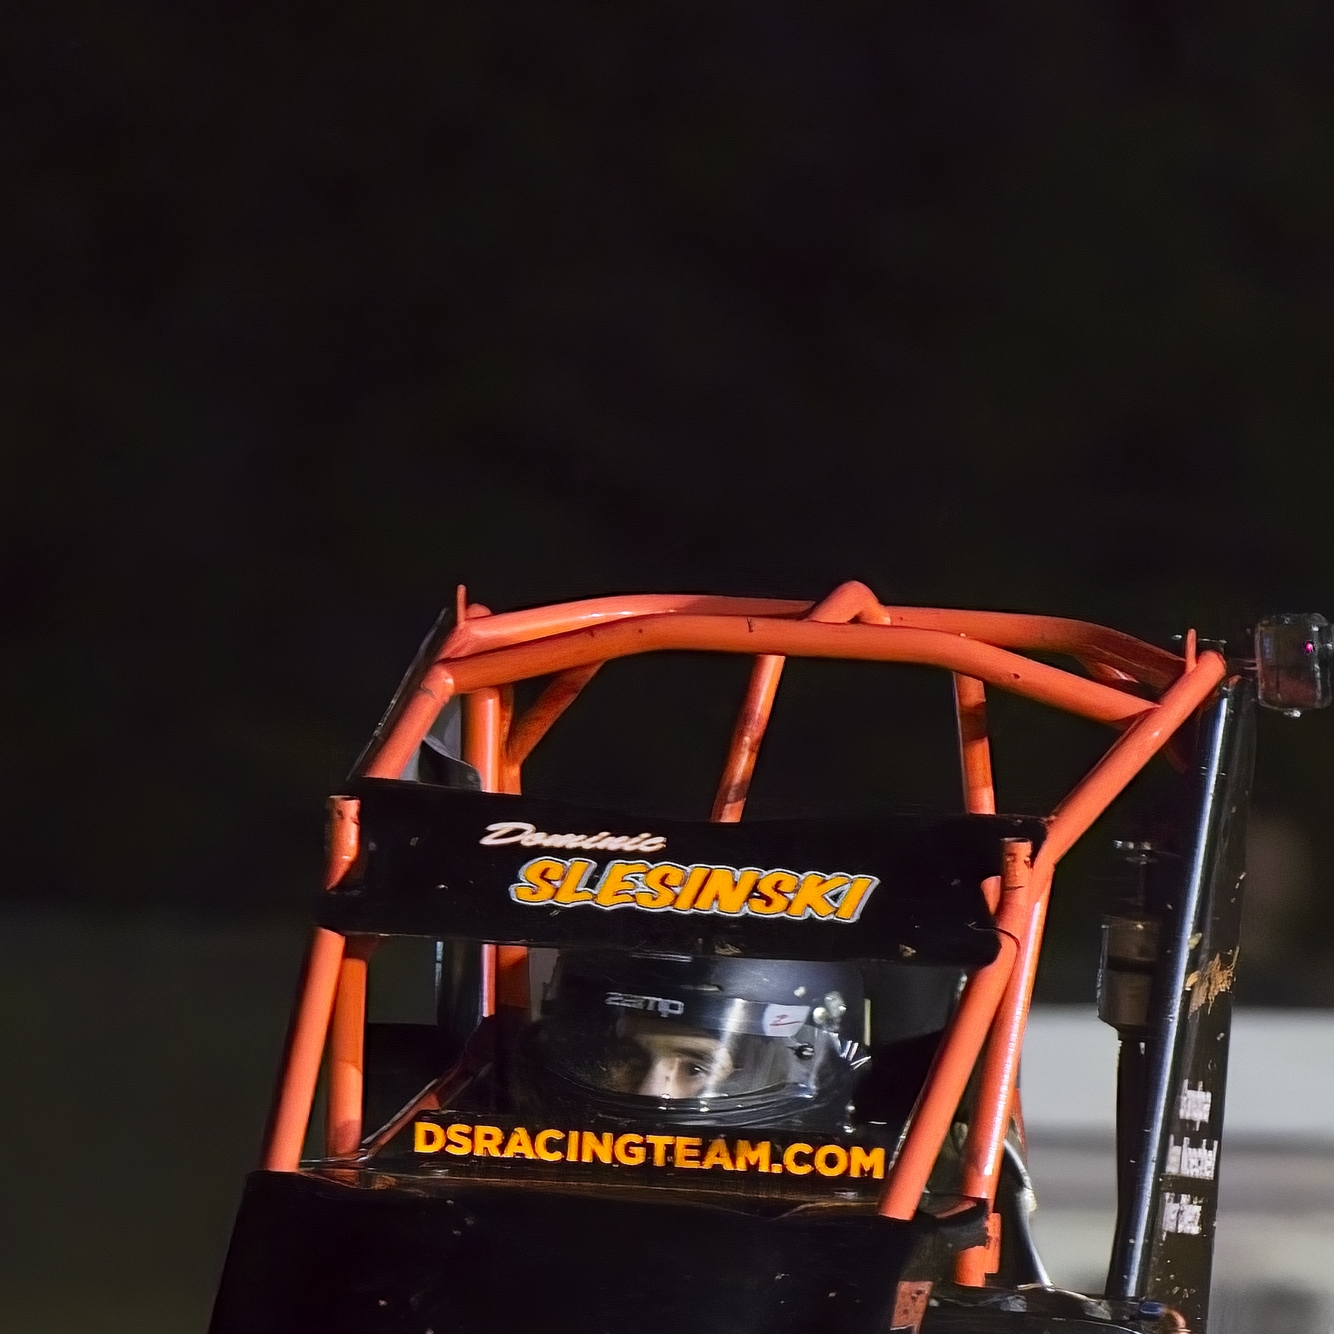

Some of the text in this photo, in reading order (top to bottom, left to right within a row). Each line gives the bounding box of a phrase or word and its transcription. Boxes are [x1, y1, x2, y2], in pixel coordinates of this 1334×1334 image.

[479, 821, 667, 852] Dominic
[511, 857, 880, 923] SLESINSKI
[413, 1120, 885, 1180] DSRACINGTEAM.COM
